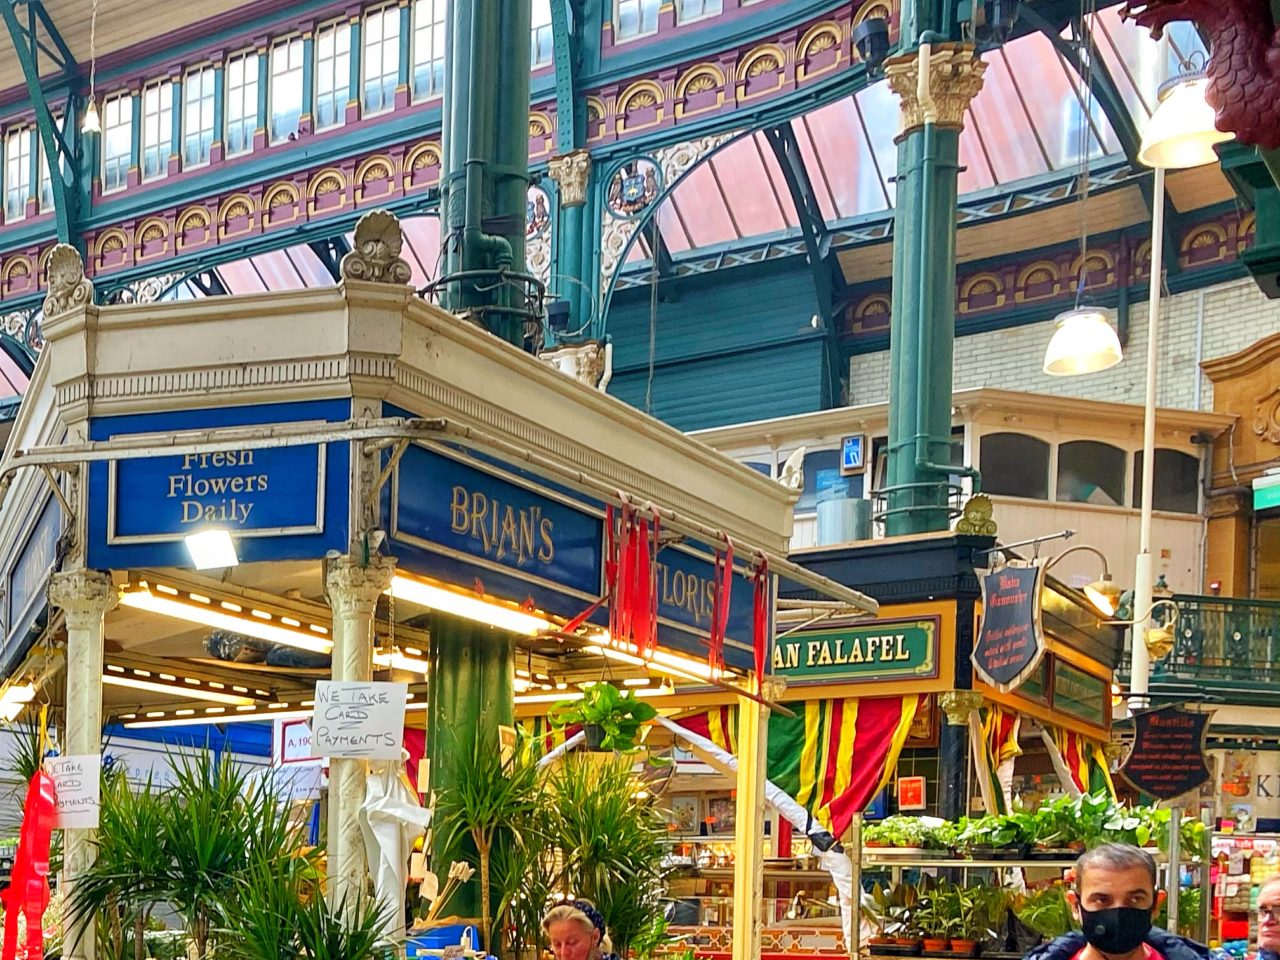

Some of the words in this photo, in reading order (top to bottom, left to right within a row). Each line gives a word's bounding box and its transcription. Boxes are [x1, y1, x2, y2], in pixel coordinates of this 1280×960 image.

[181, 450, 254, 469] Fresh
[167, 474, 268, 497] Flowers
[180, 498, 254, 524] Daily
[450, 486, 554, 566] BRIAN'S
[654, 563, 723, 624] LORIS
[806, 635, 910, 666] FALAFEL
[318, 685, 339, 703] WE
[341, 687, 389, 704] TAKE
[325, 705, 368, 720] CARD
[317, 726, 396, 747] PAYMENTS
[57, 780, 82, 788] ARD
